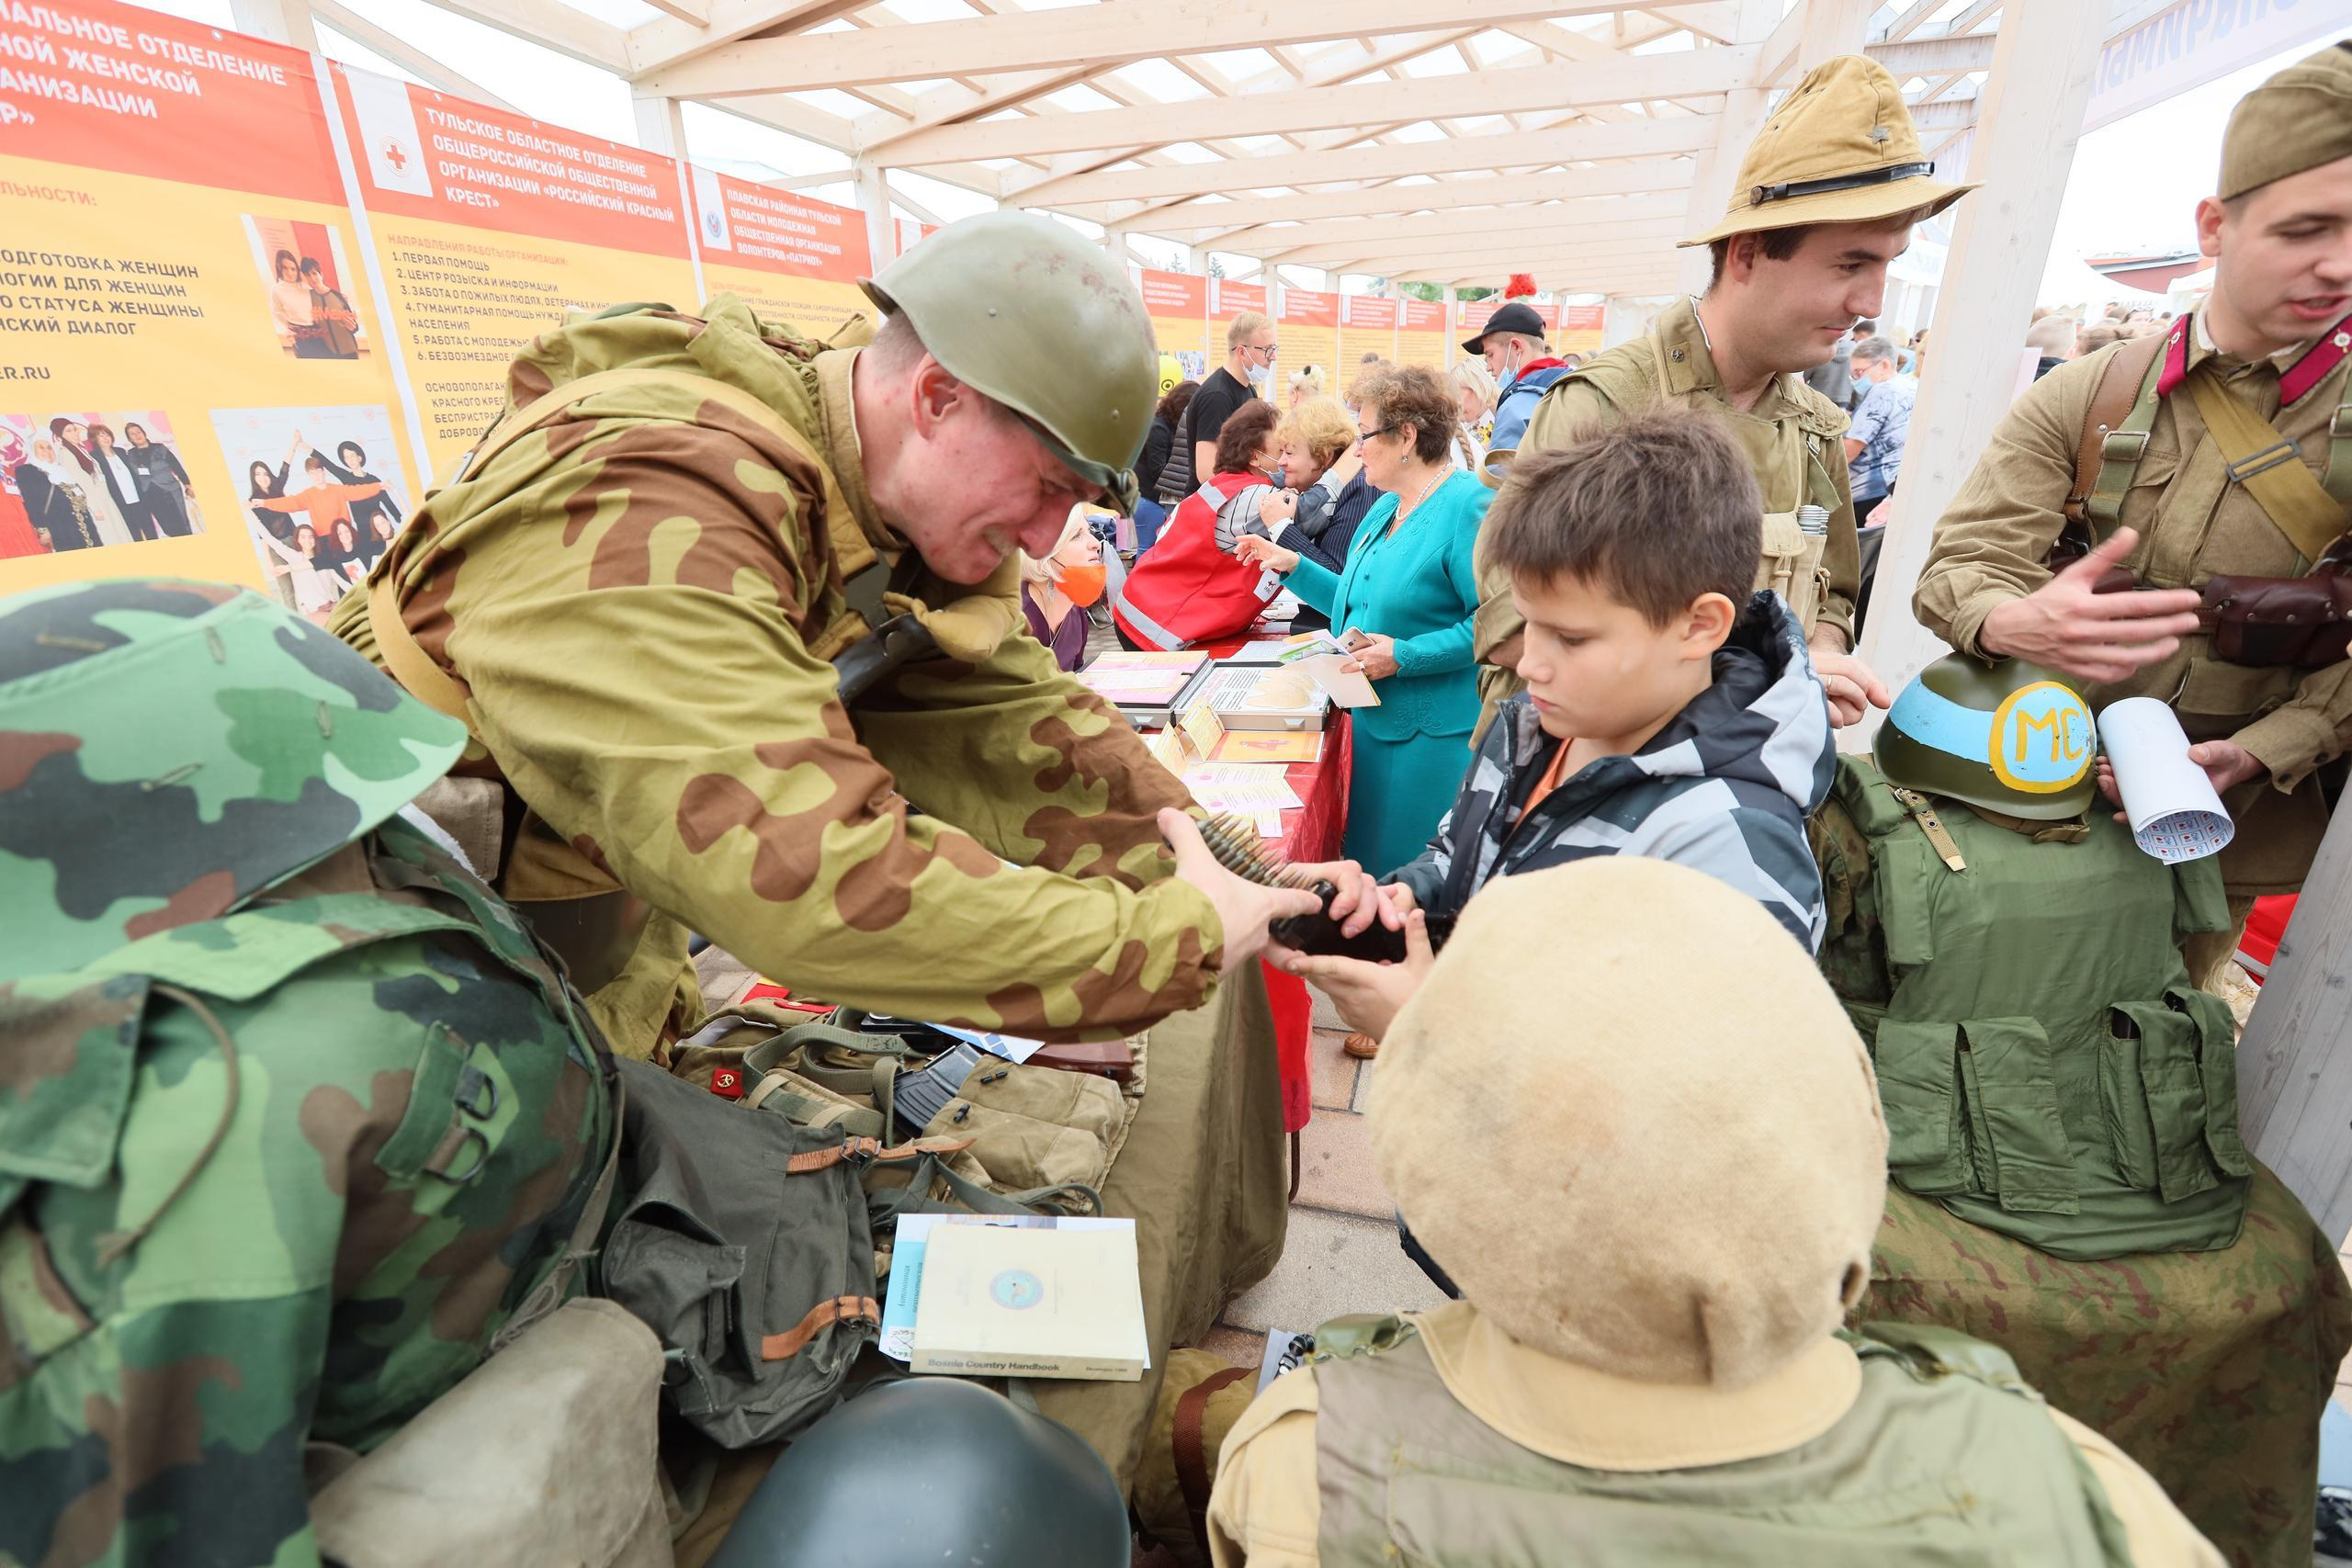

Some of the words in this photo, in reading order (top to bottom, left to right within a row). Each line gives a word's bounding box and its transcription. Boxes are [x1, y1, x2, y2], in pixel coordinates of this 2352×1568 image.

[138, 32, 287, 87] ОТДЕЛЕНИЕ
[62, 47, 201, 96] ЖЕНСКОЙ
[0, 67, 157, 118] АНИЗАЦИИ
[0, 101, 35, 125] Р»
[425, 107, 504, 142] ТУЛЬСКОЕ
[506, 129, 581, 162] ОБЛАСТНОЕ
[582, 149, 647, 179] ОТДЕЛЕНИЕ
[433, 134, 566, 180] ОБЩЕРОССИЙСКОЙ
[568, 166, 658, 201] ОБЩЕСТВЕННОЙ
[439, 160, 540, 196] ОРГАНИЗАЦИИ
[543, 186, 625, 213] «РОССИЙСКИЙ
[626, 201, 675, 223] КРАСНЫЙ
[446, 186, 500, 210] КРЕСТ»
[727, 188, 769, 210] ПЛАВСКАЯ
[771, 199, 807, 218] РАЙОННАЯ
[808, 210, 842, 225] ТУЛЬСКОЙ
[730, 208, 765, 223] ОБЛАСТИ
[734, 226, 794, 244] ОБЩЕСТВЕННАЯ
[388, 233, 466, 253] НАПРАВЛЕНИЯ
[467, 244, 504, 258] РАБОТЫ
[505, 248, 569, 266] ОРГАНИЗАЦИИ:
[737, 243, 785, 260] ВОЛОНТЕРОВ
[0, 249, 114, 272] ОДГОТОВКА
[118, 259, 199, 279] ЖЕНЩИН
[392, 251, 401, 262] 1.
[402, 252, 445, 266] ПЕРВАЯ
[446, 256, 490, 272] ПОМОЩЬ
[64, 276, 102, 292] ДЛЯ
[108, 279, 187, 299] ЖЕНЩИН
[396, 268, 407, 278] 2.
[407, 269, 442, 281] ЦЕНТР
[443, 273, 490, 287] РОЗЫСКА
[491, 278, 498, 288] И
[499, 278, 559, 293] ИНФОРМАЦИИ
[18, 296, 104, 314] СТАТУСА
[109, 301, 205, 319] ЖЕНЩИНЫ
[400, 285, 411, 295] 3.
[412, 286, 451, 299] ЗАБОТА
[452, 289, 459, 299] О
[460, 290, 509, 303] ПОЖИЛЫХ
[510, 295, 544, 307] ЛЮДЯХ,
[544, 298, 589, 309] ВЕТЕРАНАХ
[405, 302, 415, 312] 4.
[416, 302, 494, 317] ГУМАНИТАРНАЯ
[495, 309, 535, 320] ПОМОЩЬ
[67, 321, 137, 335] ДИАЛОГ
[410, 319, 470, 331] НАСЕЛЕНИЯ
[413, 334, 424, 344] 5.
[424, 334, 462, 345] РАБОТА
[464, 336, 470, 345] С
[418, 351, 427, 360] 6.
[428, 351, 510, 362] БЕЗВОЗМЕЗДНОЕ
[432, 397, 481, 407] КРАСНОГО
[482, 397, 506, 406] КРЕС
[927, 1359, 964, 1368] Bosnia
[966, 1360, 1007, 1371] Country
[1008, 1361, 1060, 1371] Handbook
